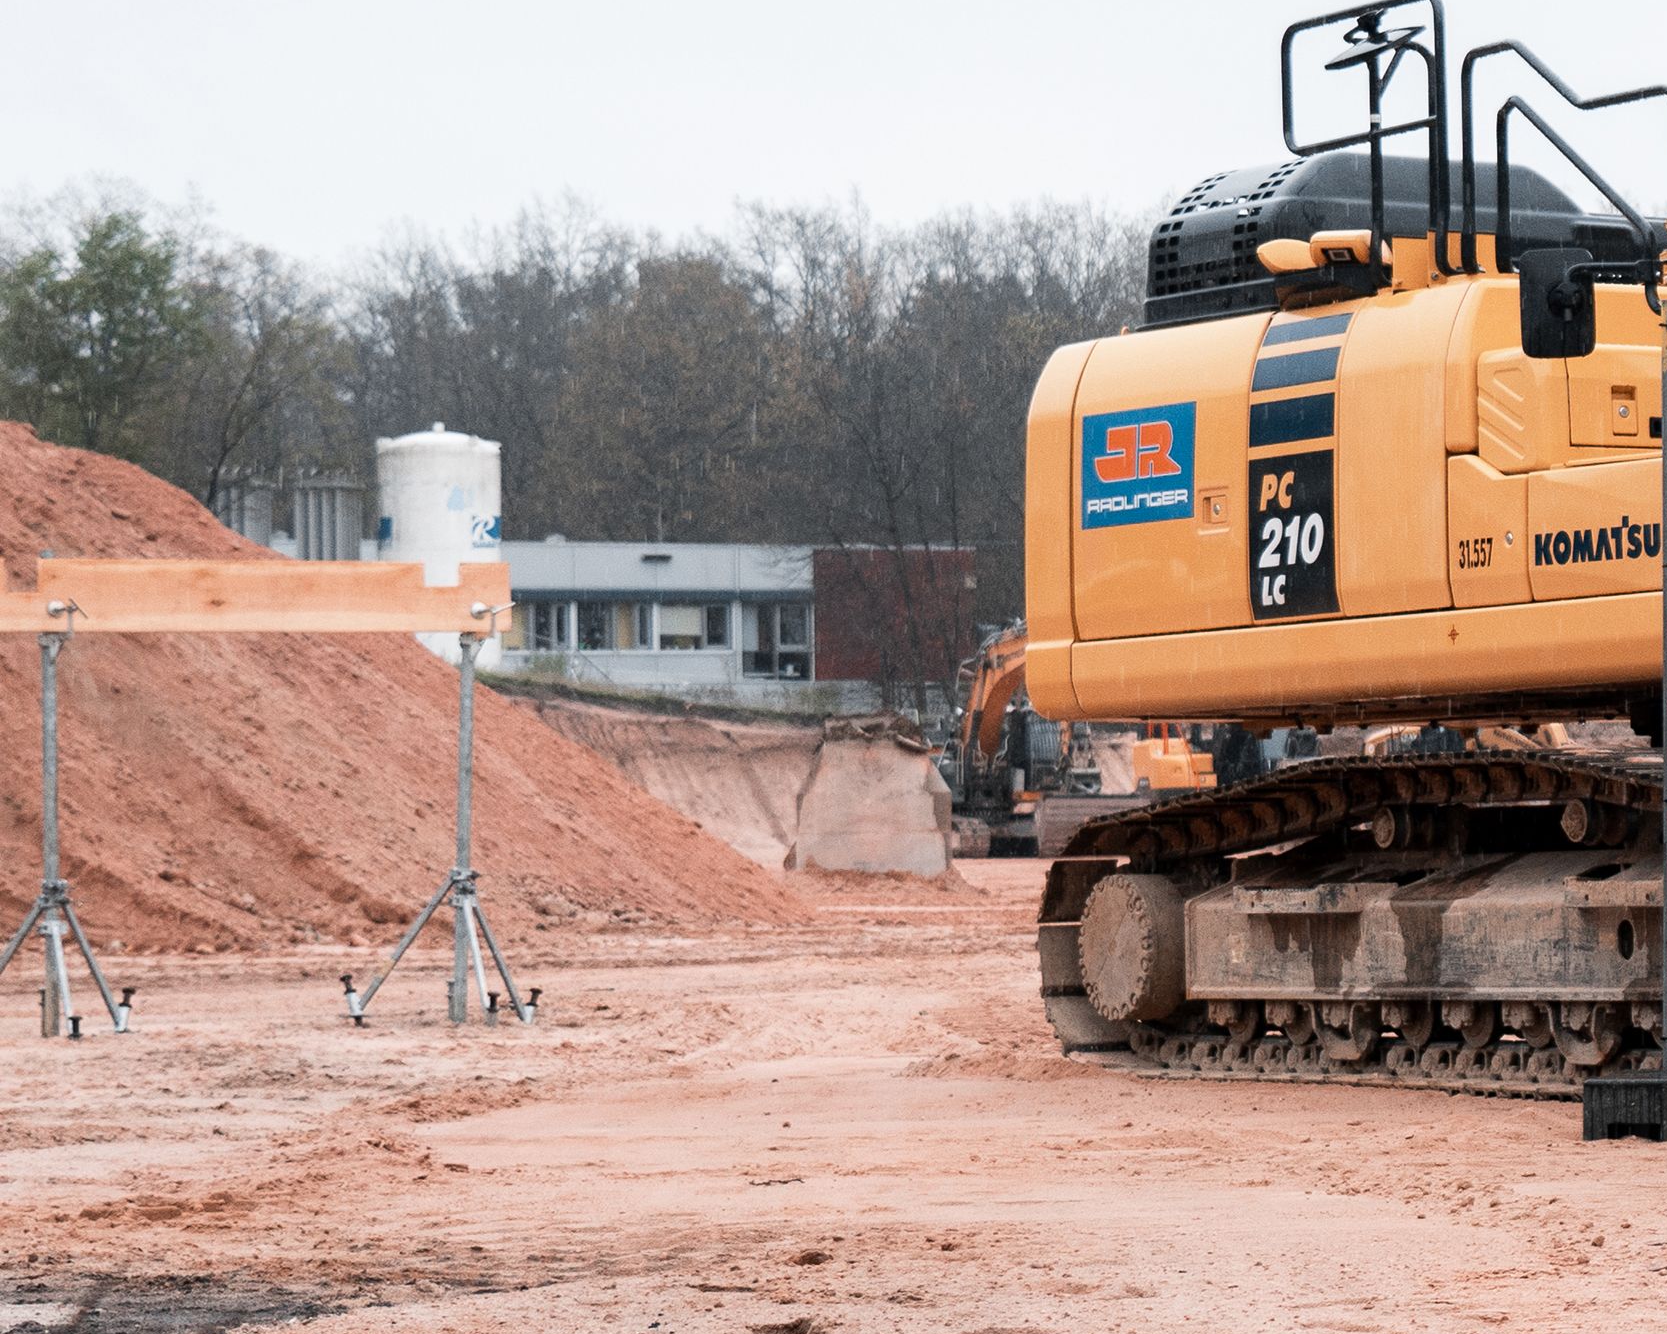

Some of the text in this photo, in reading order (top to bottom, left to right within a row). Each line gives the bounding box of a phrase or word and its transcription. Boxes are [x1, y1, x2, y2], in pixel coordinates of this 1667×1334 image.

[1095, 420, 1181, 483] JR
[1259, 471, 1295, 512] PC
[1258, 513, 1325, 568] 210
[1459, 537, 1493, 569] 31.557
[1534, 516, 1661, 566] KOMATSU
[1262, 574, 1287, 606] LC
